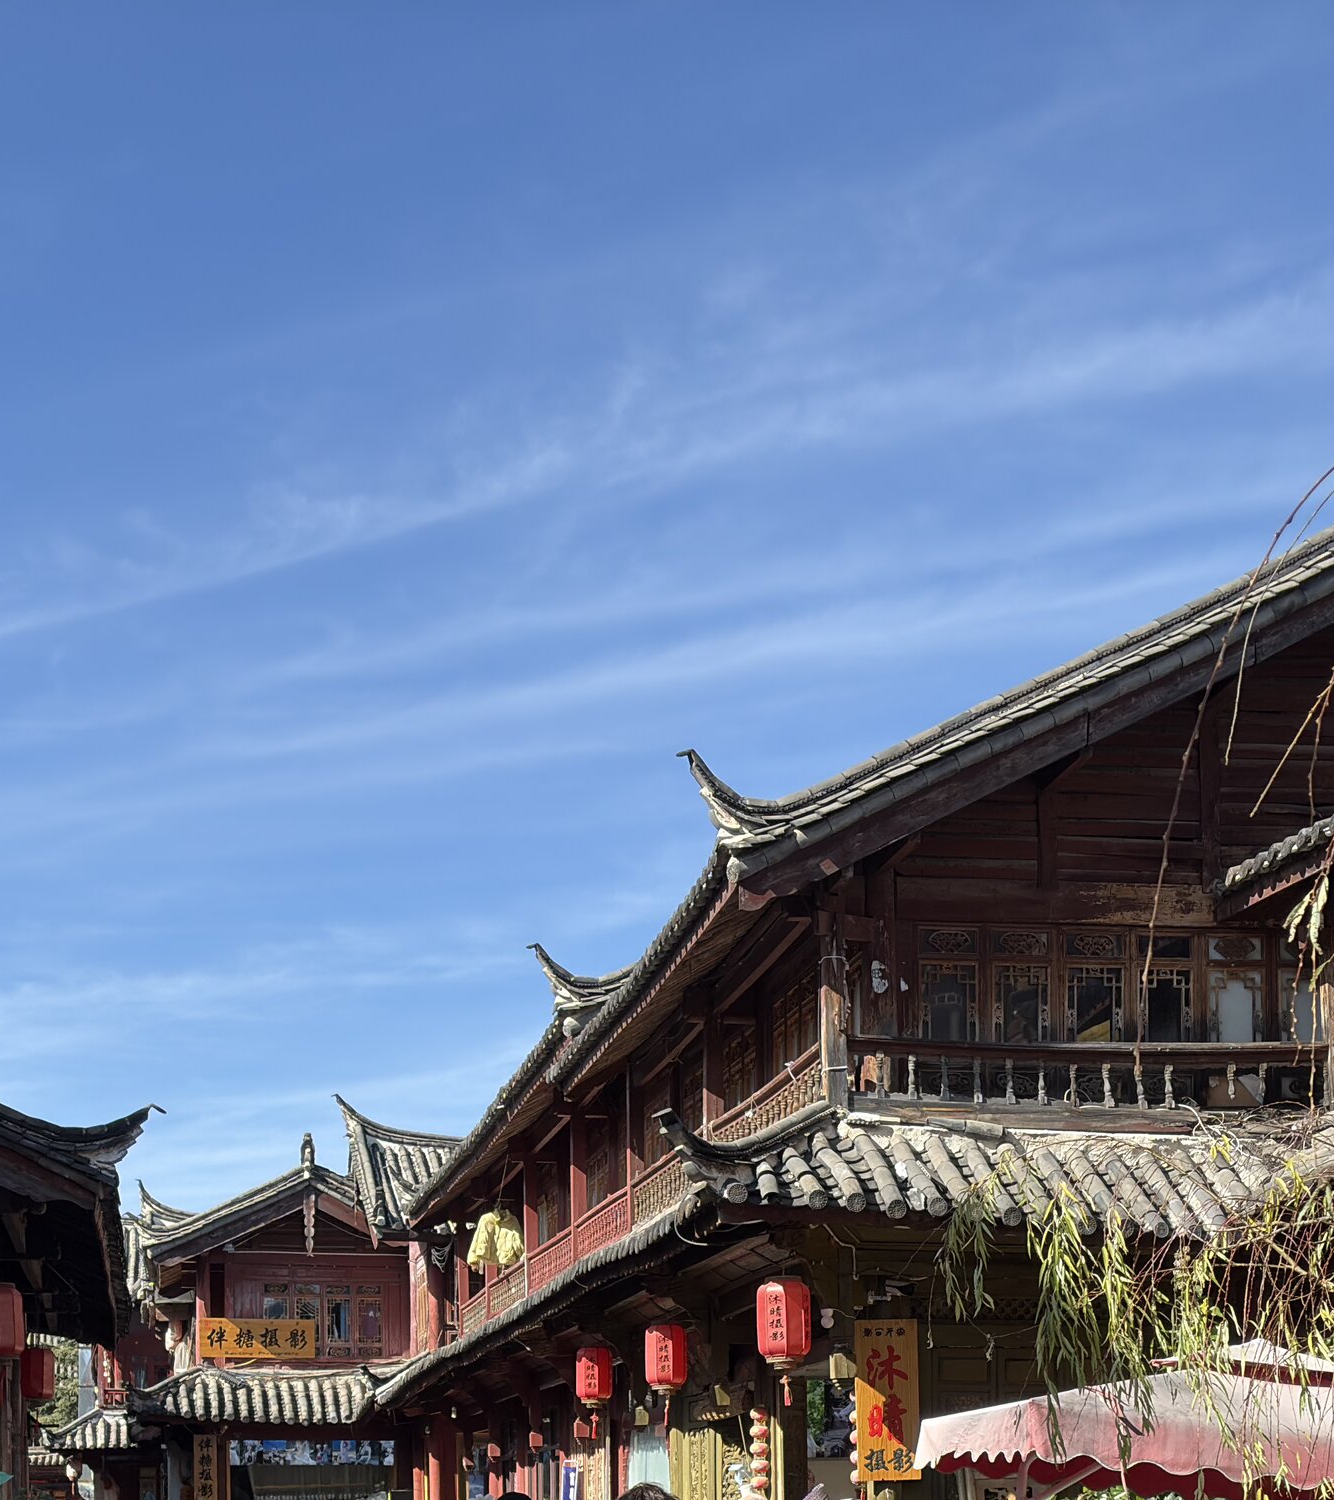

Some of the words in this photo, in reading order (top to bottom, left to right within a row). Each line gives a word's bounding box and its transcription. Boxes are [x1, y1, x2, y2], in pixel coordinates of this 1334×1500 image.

[768, 1294, 785, 1342] 沐晴摄影
[207, 1326, 308, 1351] 伴糖摄影
[864, 1447, 914, 1473] 摄影
